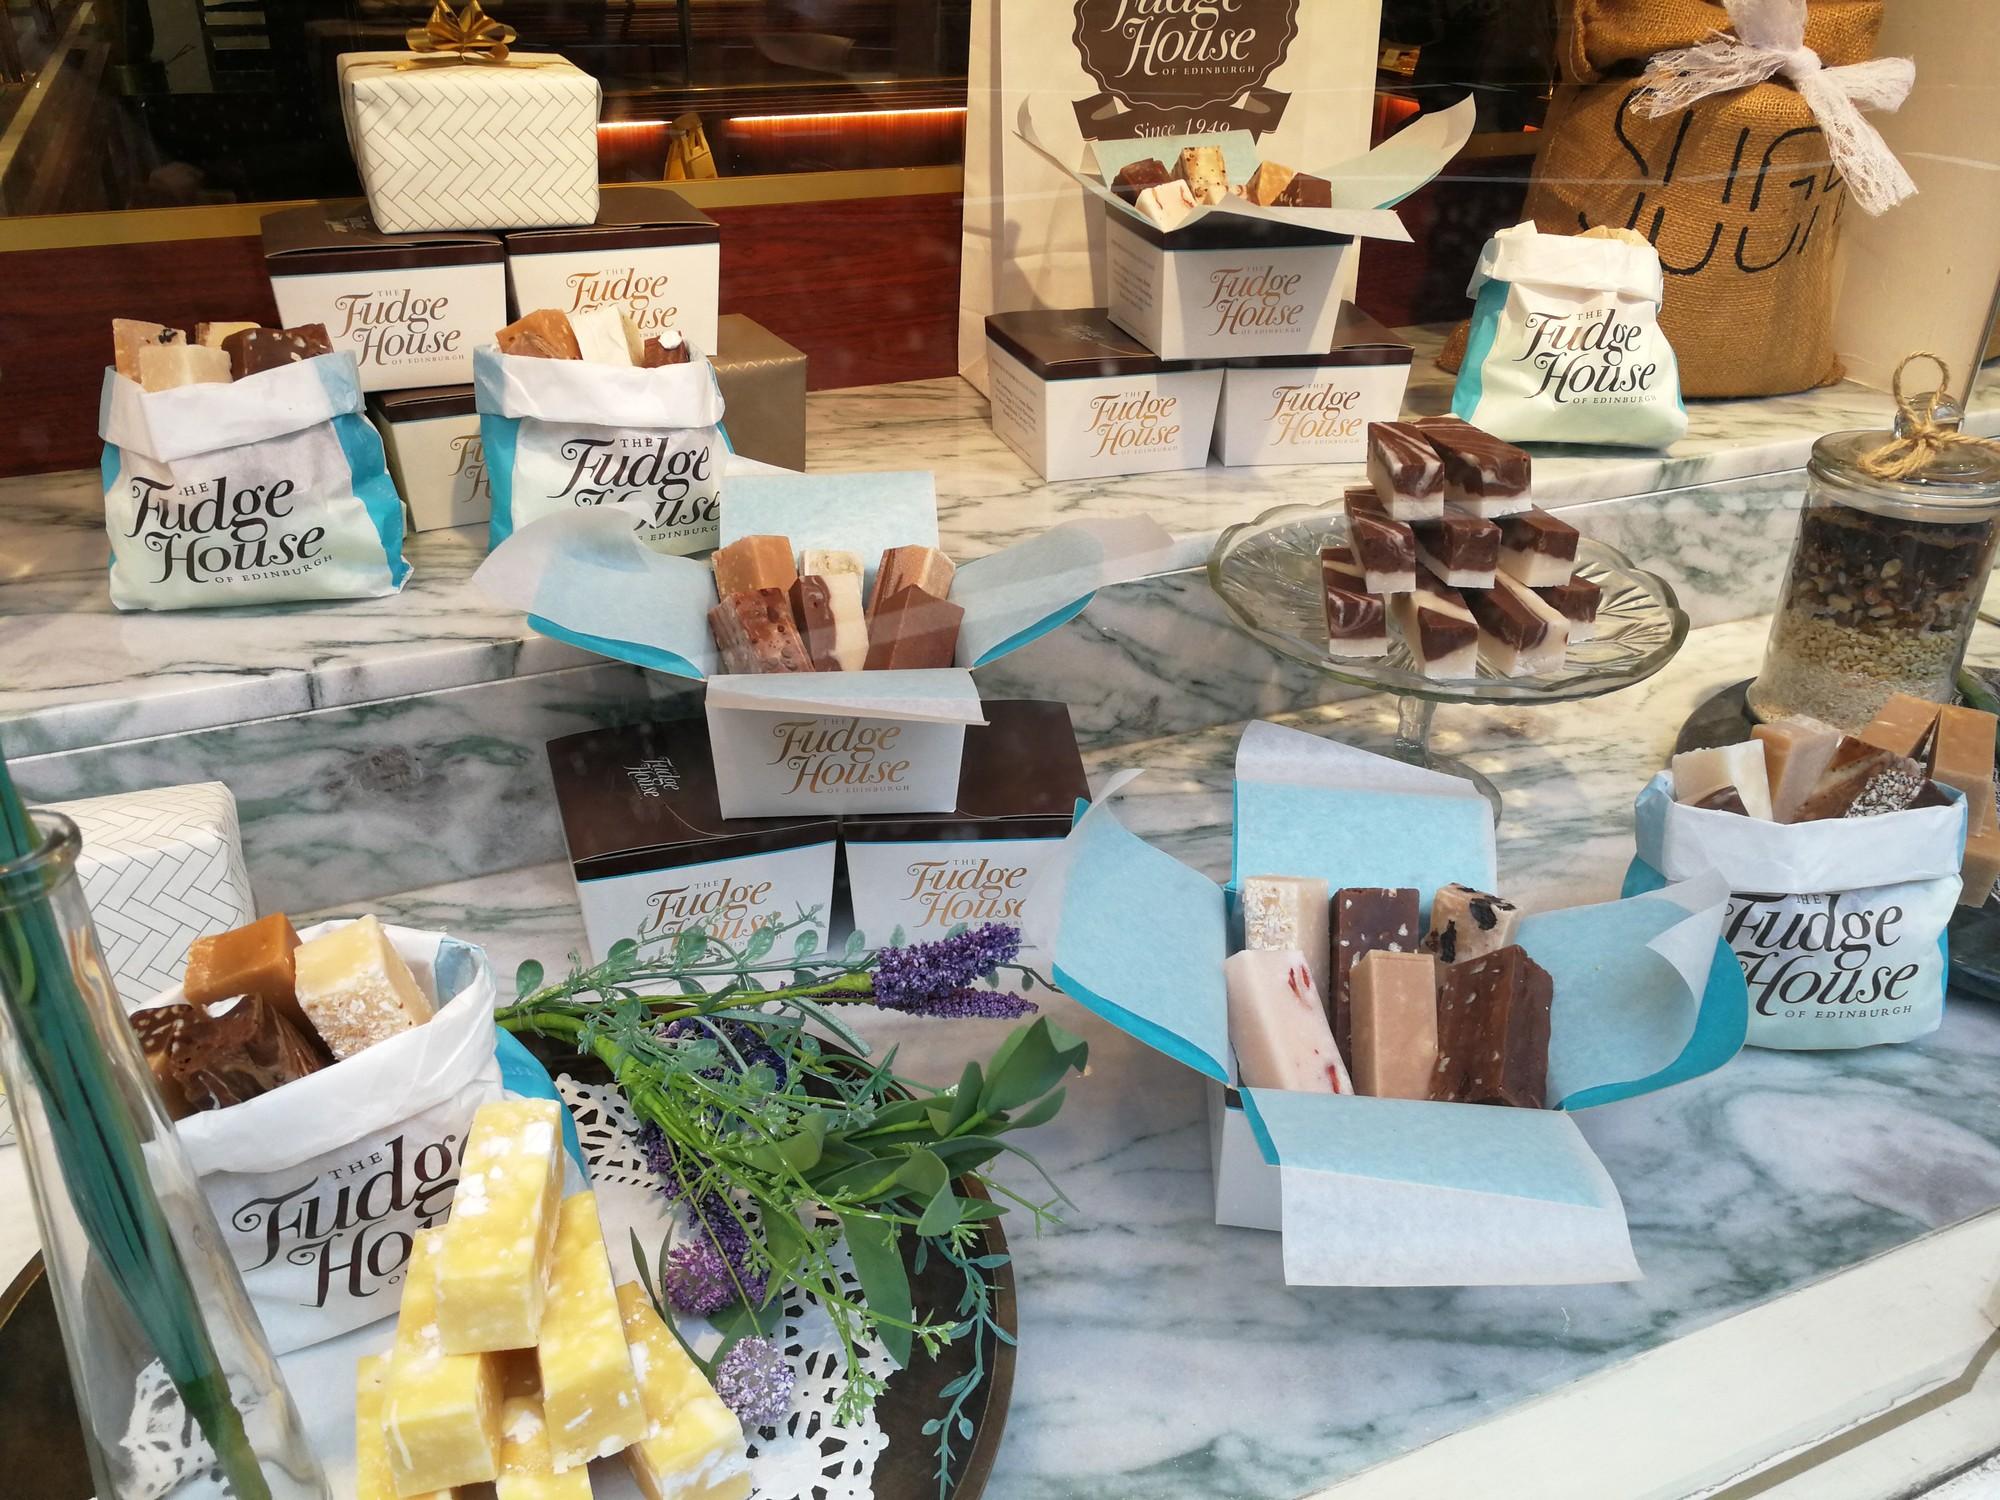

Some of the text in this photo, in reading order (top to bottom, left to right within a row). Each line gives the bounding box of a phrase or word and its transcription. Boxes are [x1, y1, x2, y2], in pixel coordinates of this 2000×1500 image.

[1113, 16, 1256, 78] House
[1162, 65, 1256, 76] OF EDINBURGH
[377, 289, 399, 297] THE
[566, 267, 669, 314] Fudge
[1201, 265, 1302, 309] Fudge
[334, 288, 449, 338] Fudge
[580, 302, 678, 330] use
[1207, 298, 1304, 337] House
[1576, 309, 1603, 321] THE
[352, 324, 461, 367] House
[1512, 308, 1642, 367] Fudge
[408, 355, 465, 365] EDINBURGH
[1523, 351, 1657, 404] House
[1083, 390, 1177, 432] Fudge
[1263, 383, 1361, 421] Fudge
[1593, 395, 1657, 404] EDINBURGH
[620, 437, 653, 448] THE
[1089, 421, 1180, 458] House
[1269, 412, 1363, 446] House
[546, 436, 711, 501] Fudge
[179, 482, 209, 496] HE
[124, 476, 295, 543] Fudge
[650, 525, 719, 541] EDINBURG
[144, 526, 325, 584] House
[214, 554, 334, 584] OF EDINBURGH
[823, 718, 846, 726] THE
[766, 717, 902, 766] Fudge
[623, 763, 660, 798] House
[641, 756, 681, 790] Fudge
[781, 753, 910, 795] House
[846, 785, 910, 794] EDINBURGH
[900, 858, 1028, 901] Fudge
[952, 858, 978, 866] THE
[693, 879, 720, 889] THE
[1795, 893, 1822, 905] THE
[643, 877, 772, 933] Fudge
[1724, 893, 1904, 971] Fudge
[1735, 950, 1920, 1017] House
[1784, 1005, 1913, 1019] OF EDINBURGH
[327, 1151, 383, 1180] THE
